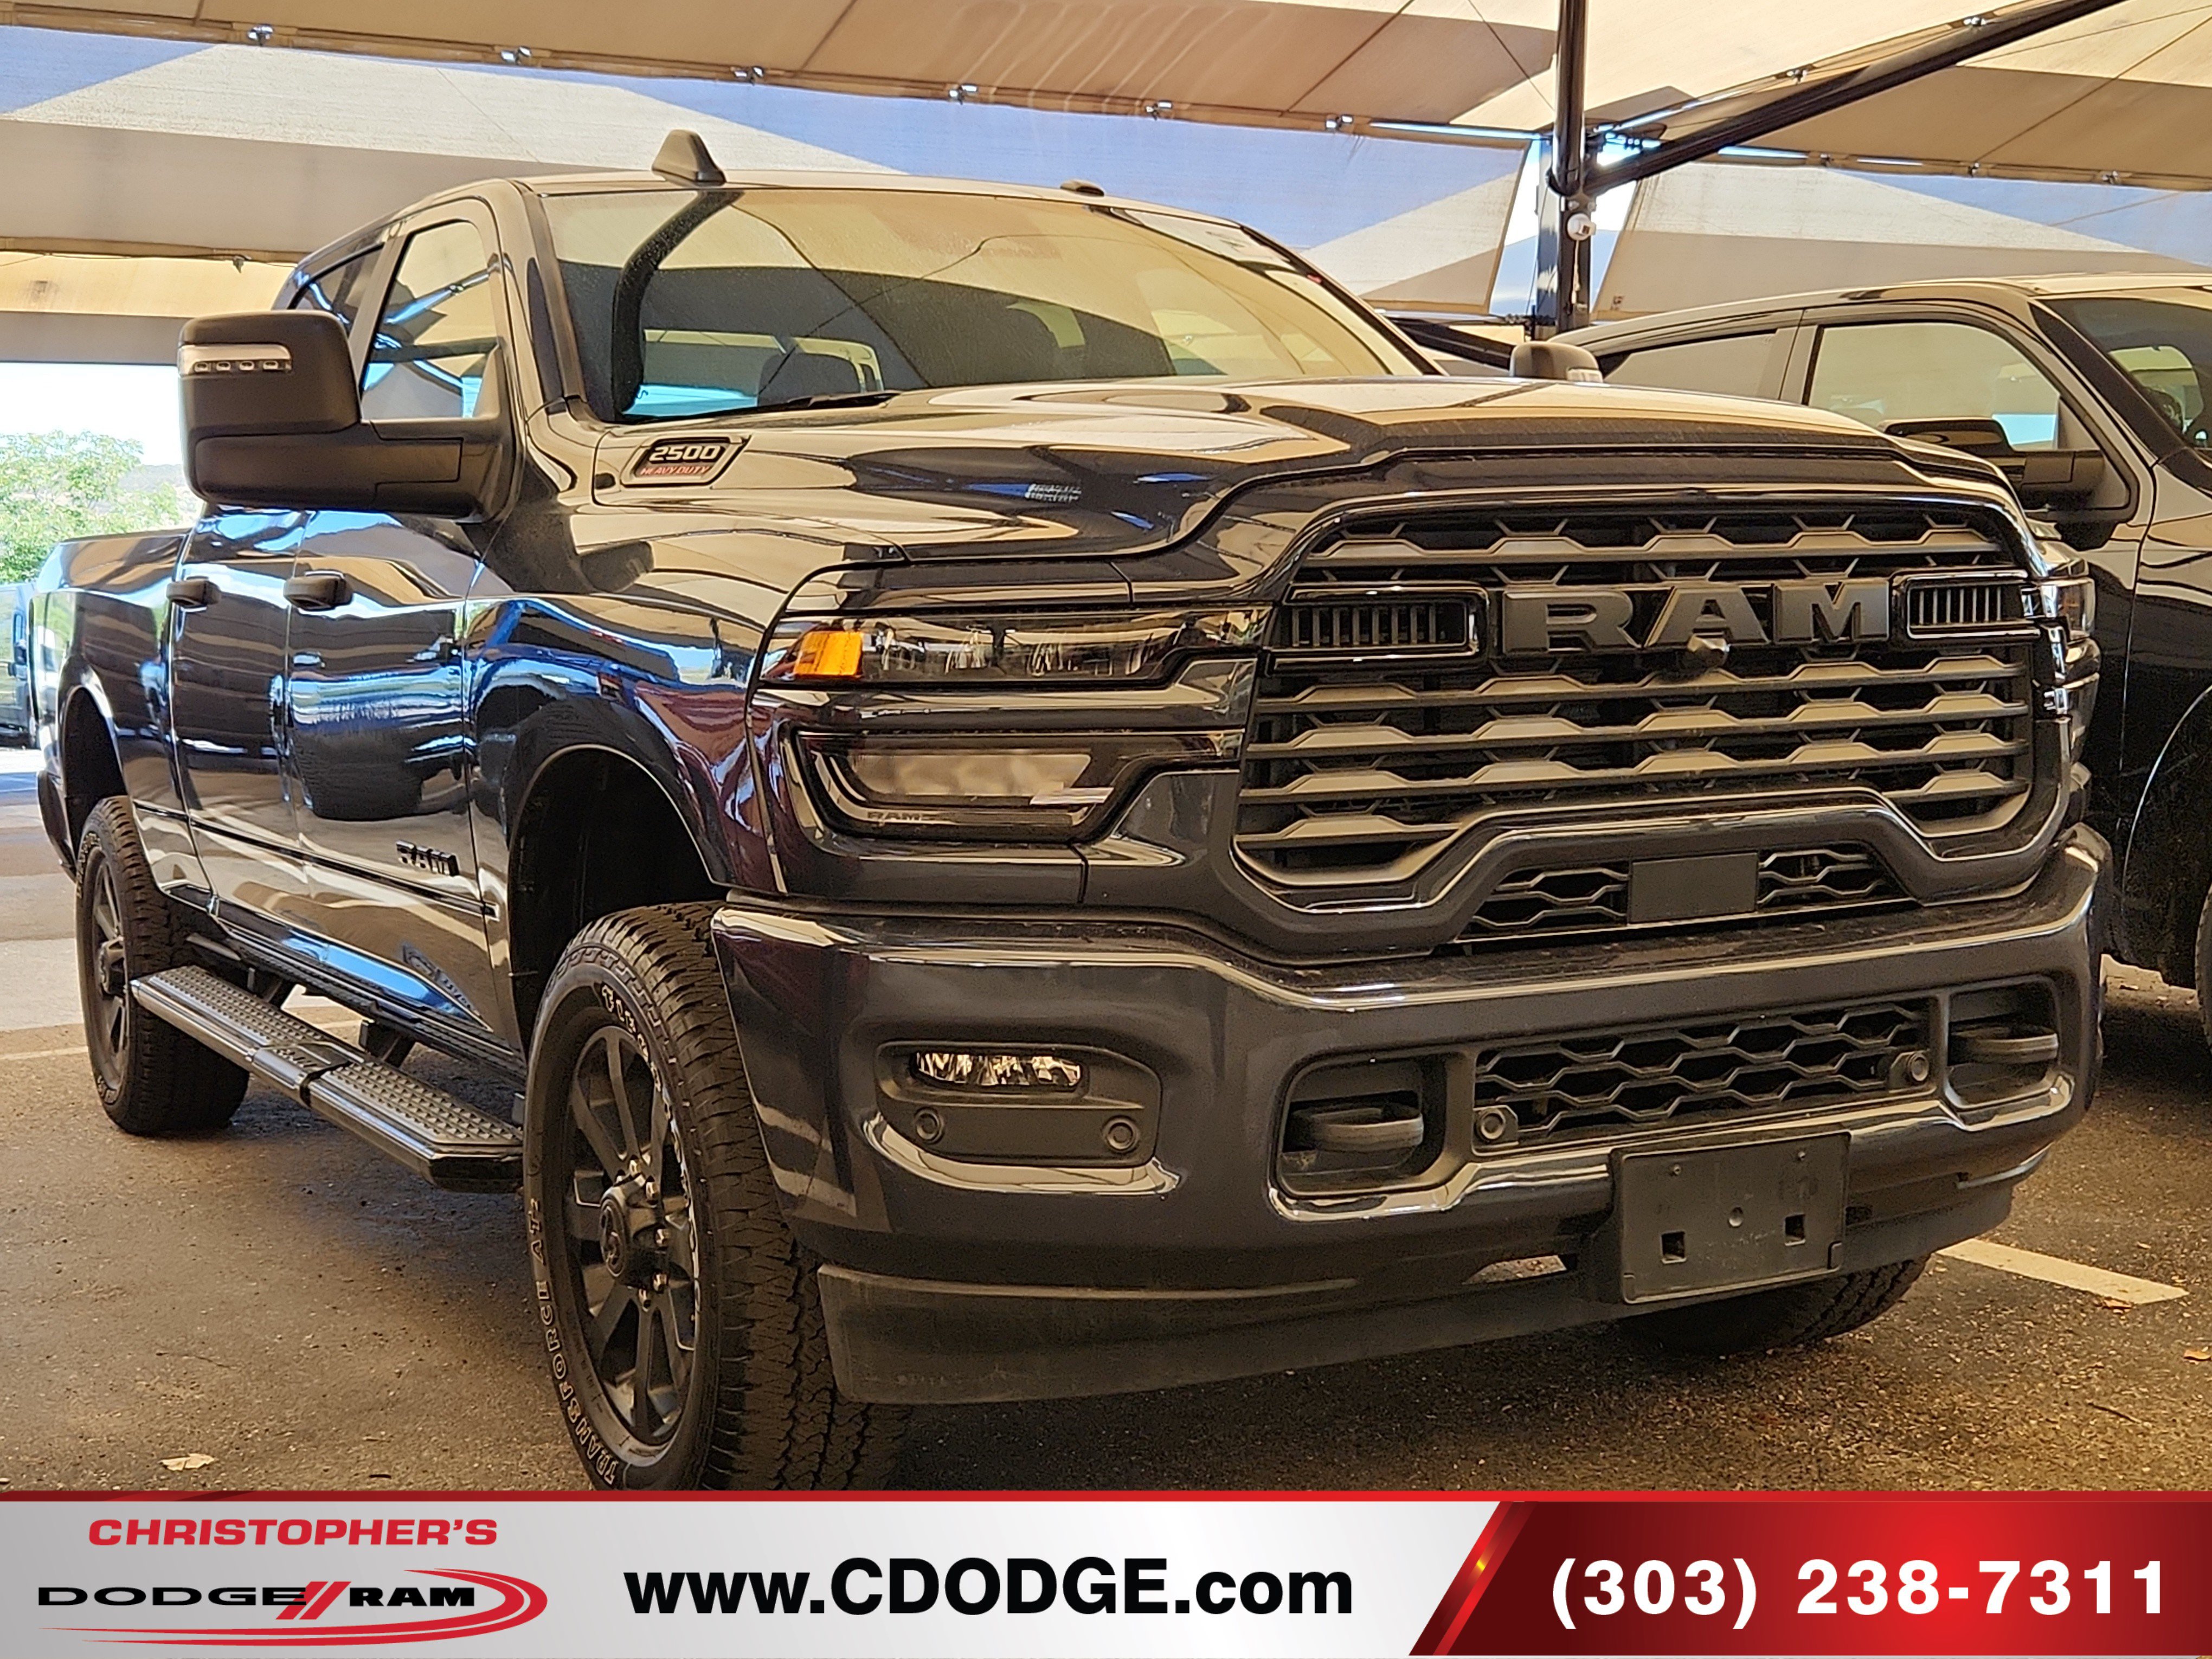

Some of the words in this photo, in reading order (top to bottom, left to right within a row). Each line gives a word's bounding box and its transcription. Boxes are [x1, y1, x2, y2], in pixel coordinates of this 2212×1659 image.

[648, 445, 721, 461] 2500
[1502, 582, 1889, 651] RAM
[536, 1281, 619, 1486] TRANSFORCE
